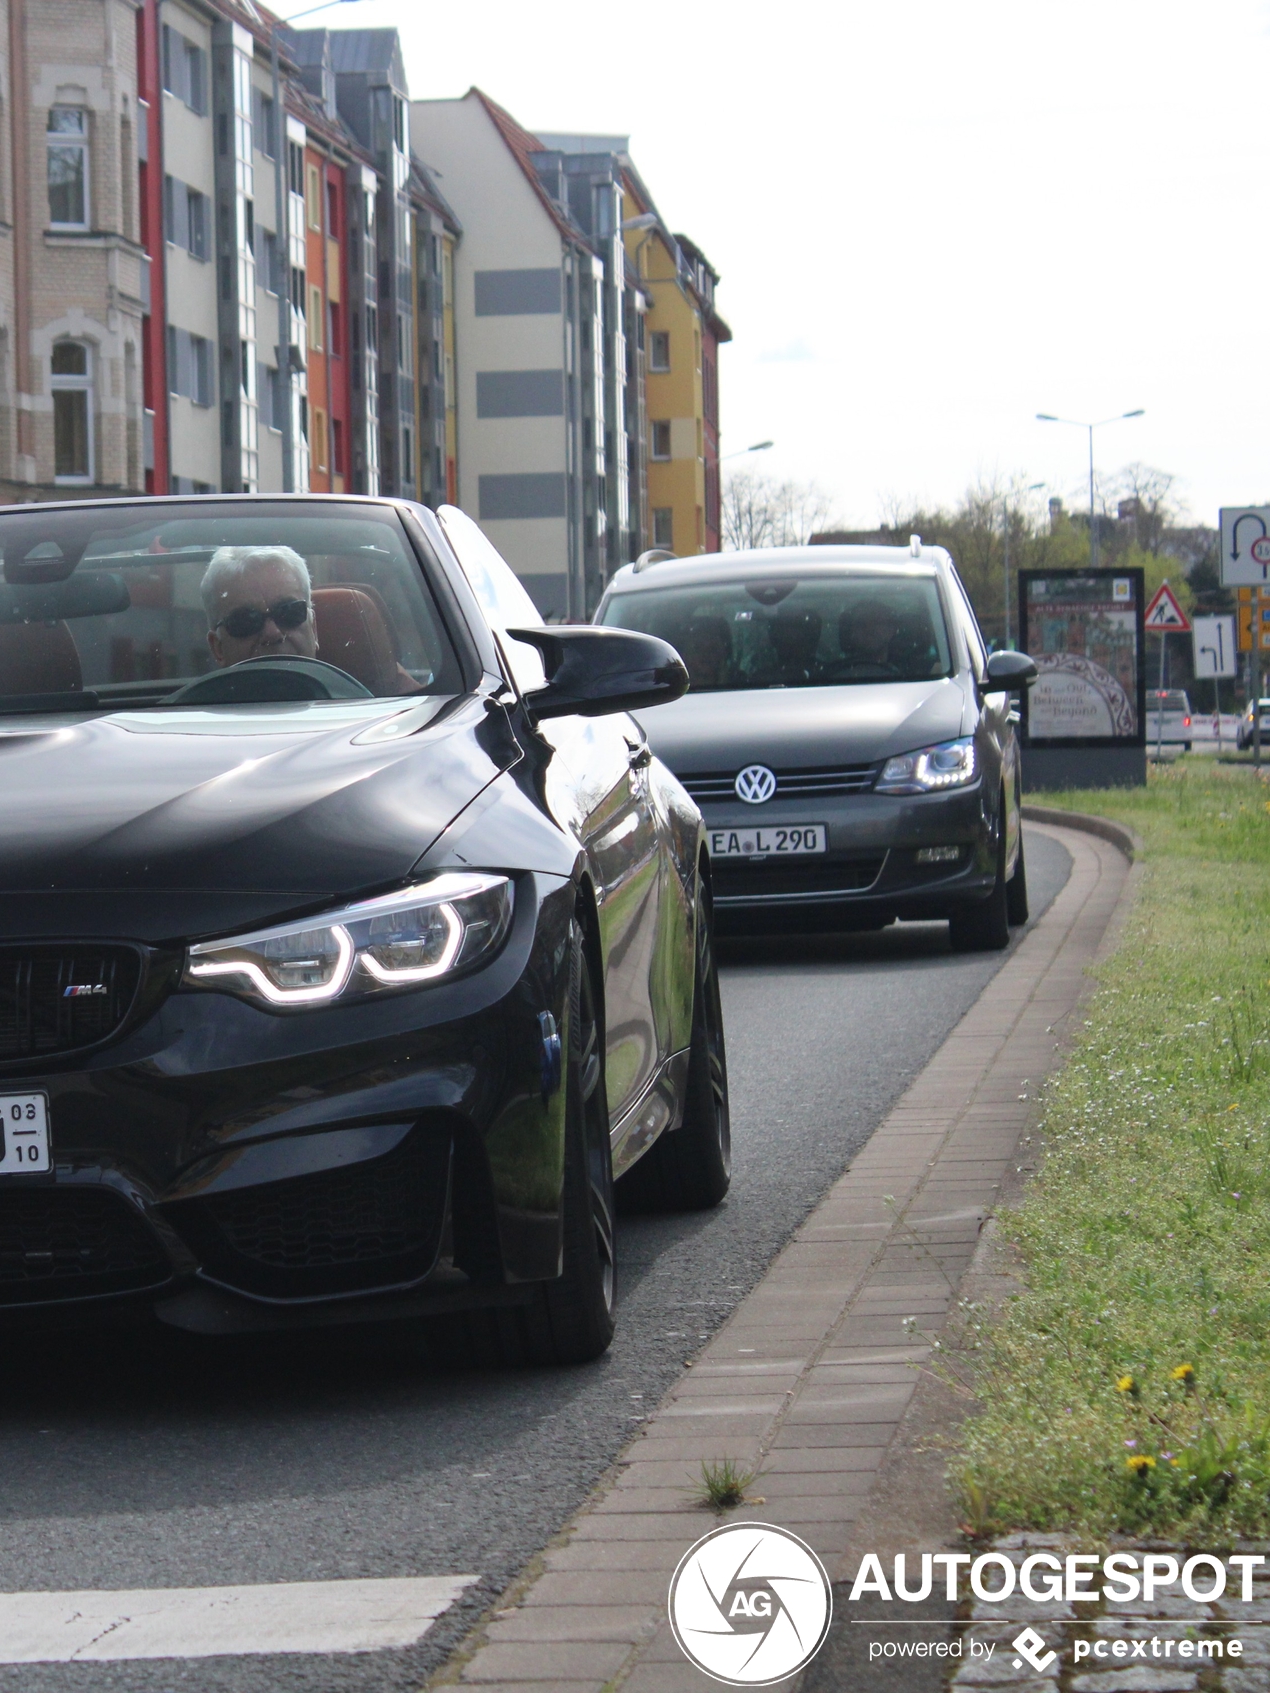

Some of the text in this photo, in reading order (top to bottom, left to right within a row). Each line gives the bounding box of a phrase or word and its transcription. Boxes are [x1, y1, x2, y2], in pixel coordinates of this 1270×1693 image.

[712, 828, 817, 854] EA L 290
[10, 1103, 37, 1121] 03
[15, 1145, 40, 1162] 10
